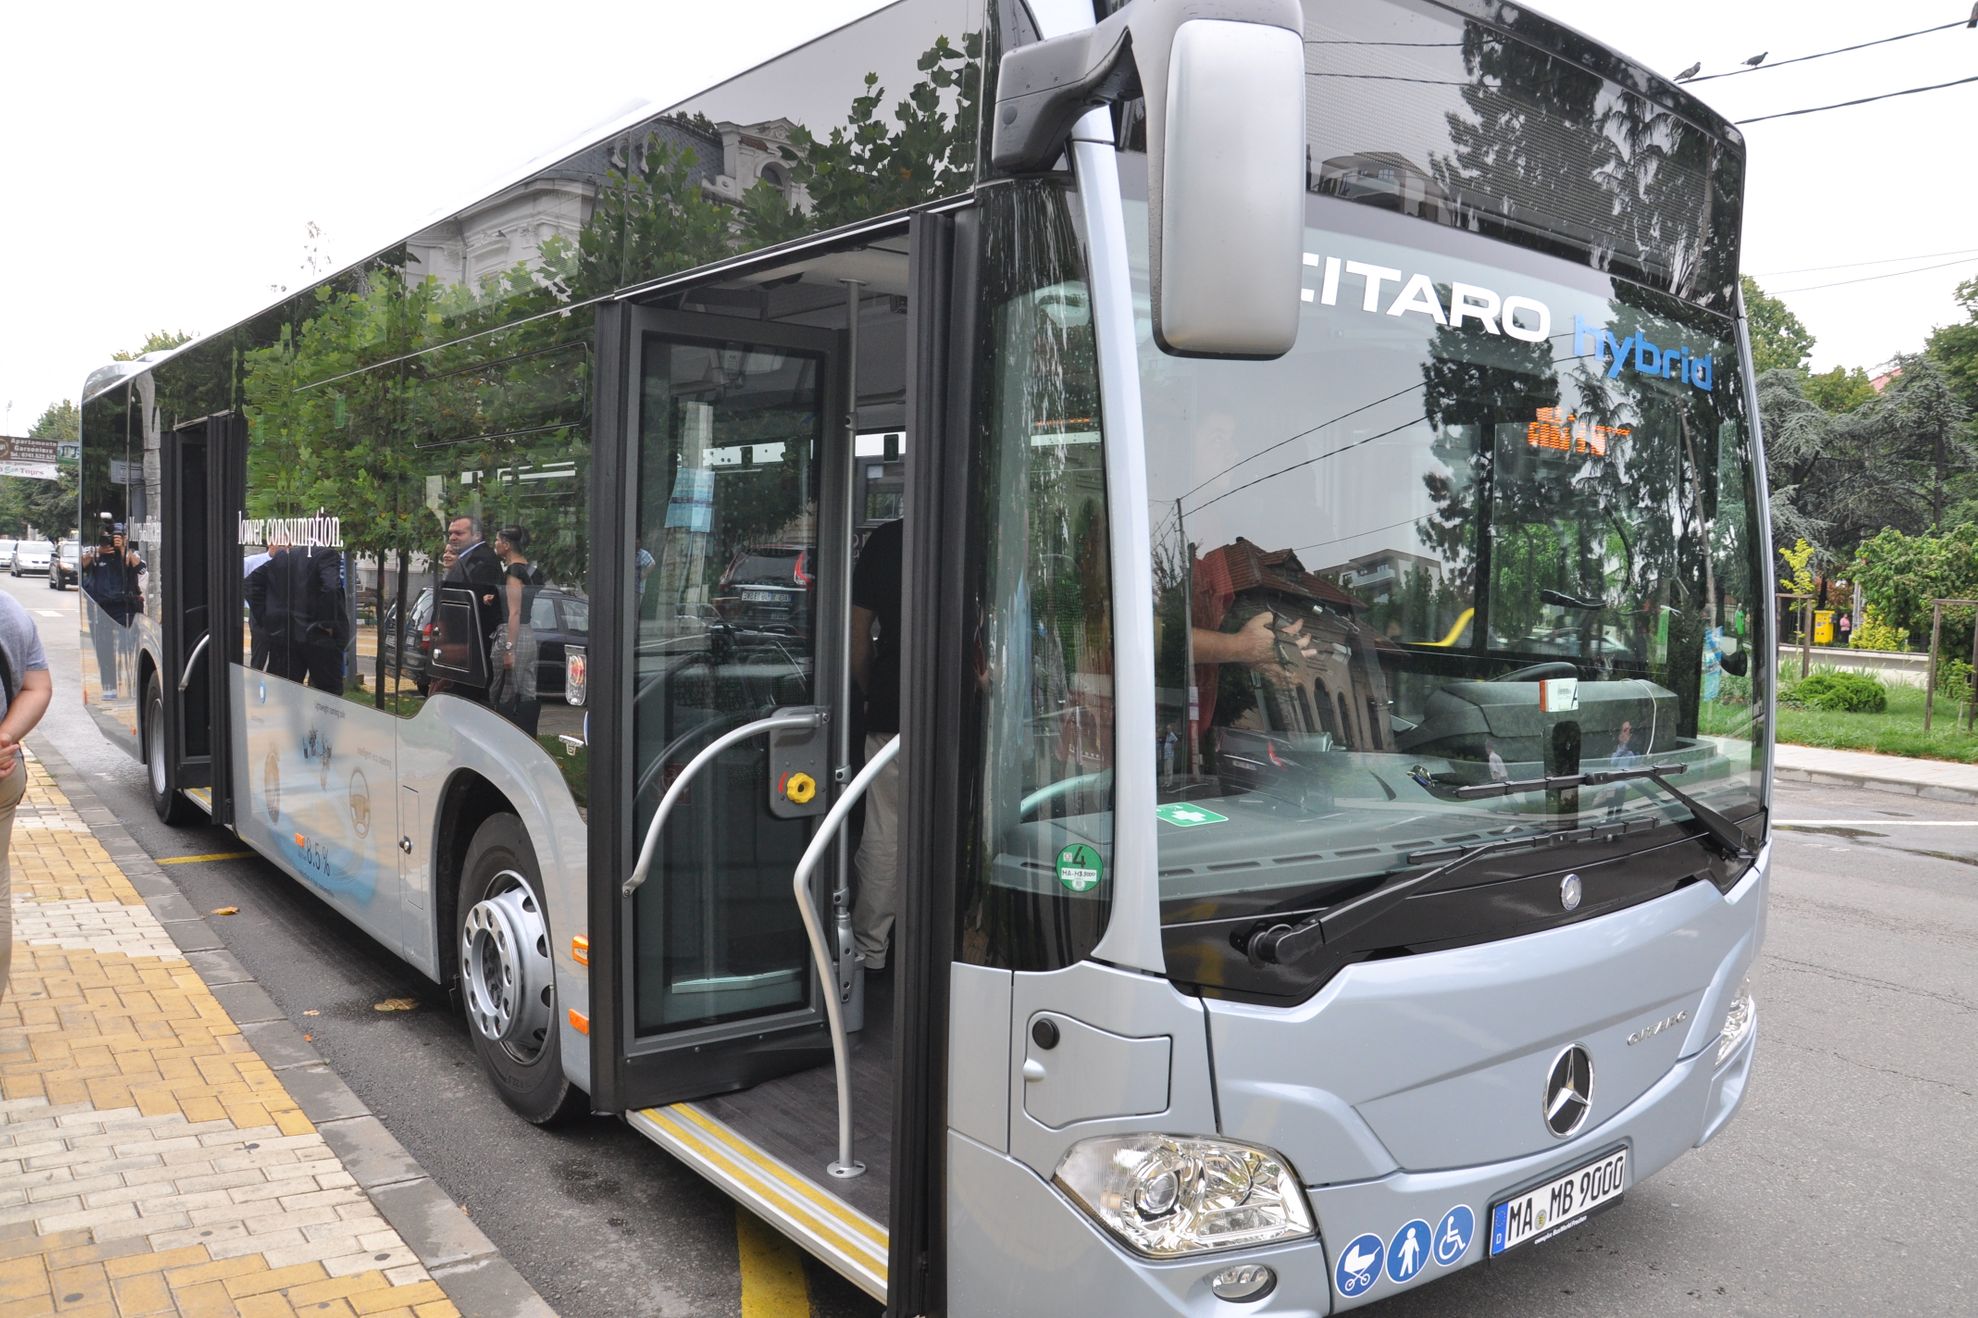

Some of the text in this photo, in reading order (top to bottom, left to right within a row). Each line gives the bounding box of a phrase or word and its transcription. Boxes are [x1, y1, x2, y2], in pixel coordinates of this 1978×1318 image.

[1573, 314, 1713, 392] hybrid
[238, 506, 344, 558] lower consumption.
[1072, 846, 1087, 869] 4
[1495, 1156, 1624, 1245] D MA MB 9000
